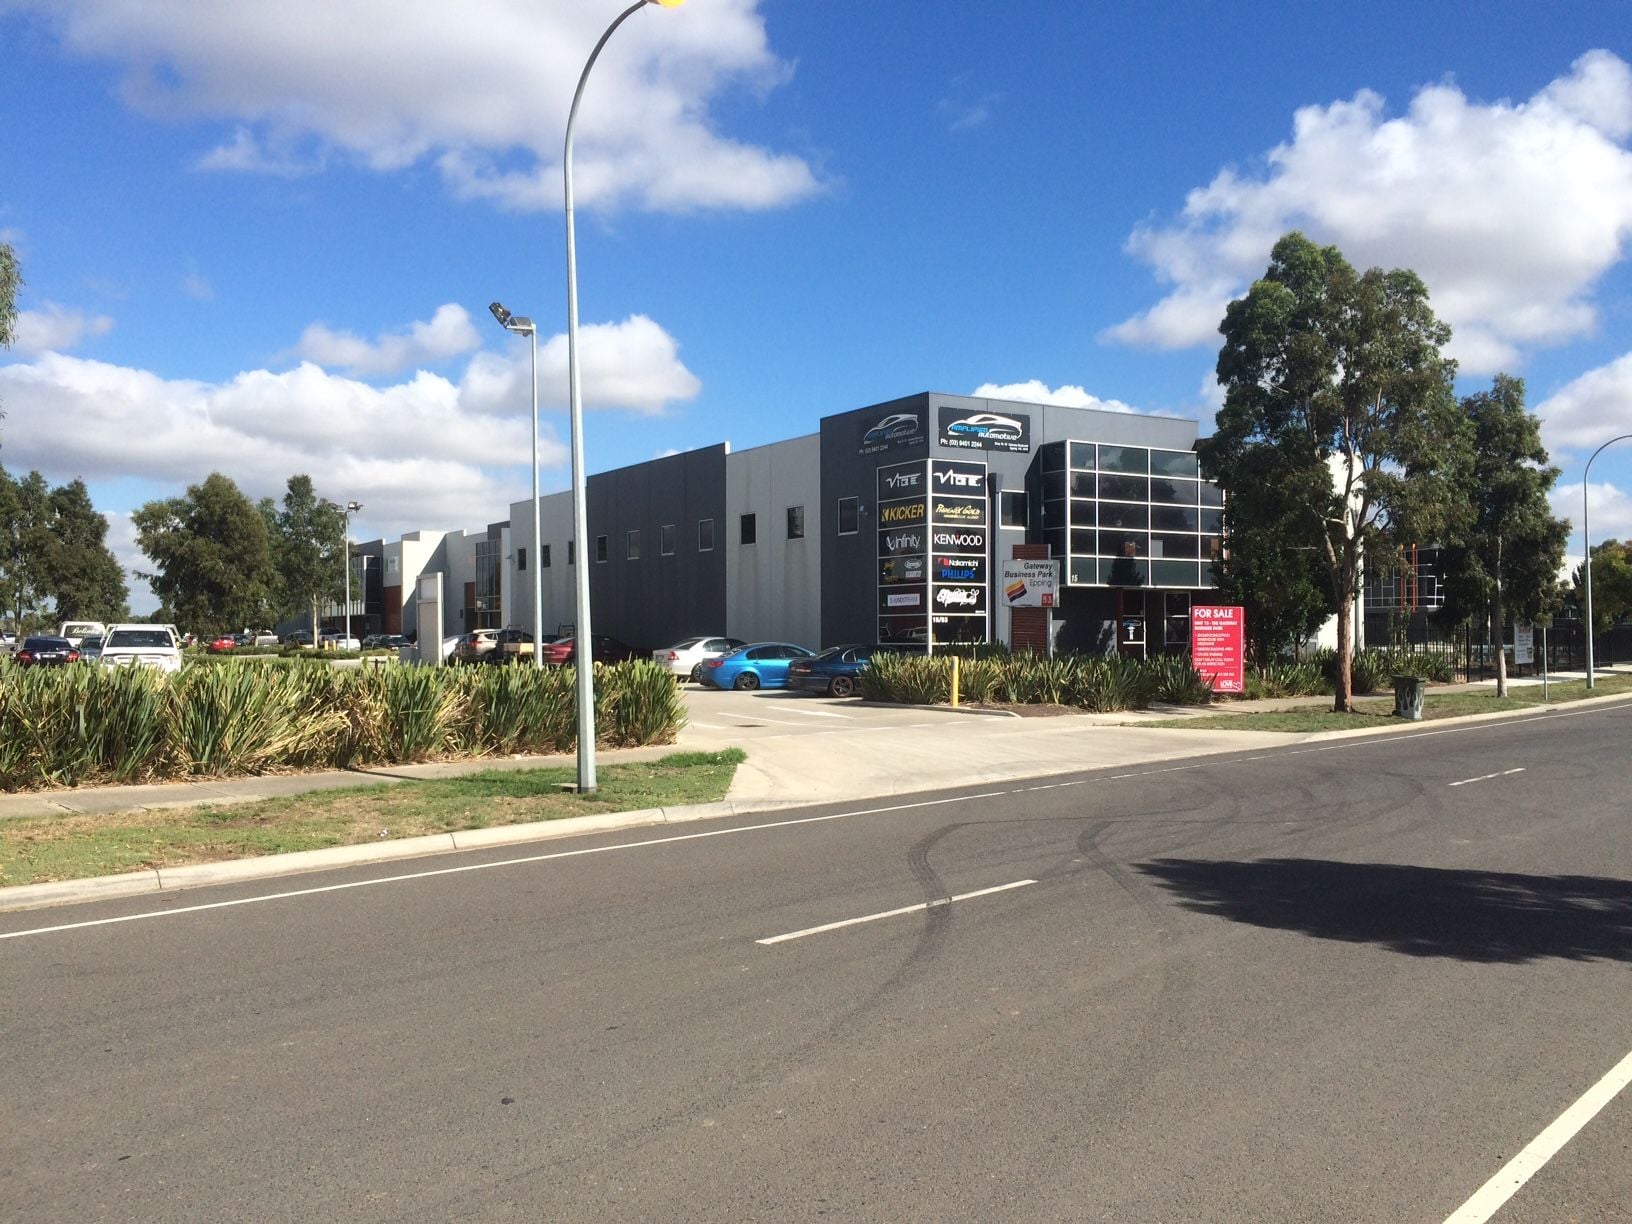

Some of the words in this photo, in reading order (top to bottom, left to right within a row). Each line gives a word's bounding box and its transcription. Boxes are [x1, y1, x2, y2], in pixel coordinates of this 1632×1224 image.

[889, 504, 925, 521] KICKER
[934, 533, 983, 546] KENWOOD
[1023, 562, 1054, 571] Gateway
[941, 569, 976, 579] PHILIPS
[1037, 570, 1053, 578] Park
[1029, 579, 1052, 587] Epping
[1194, 608, 1212, 618] FOR
[1213, 608, 1234, 618] SALE
